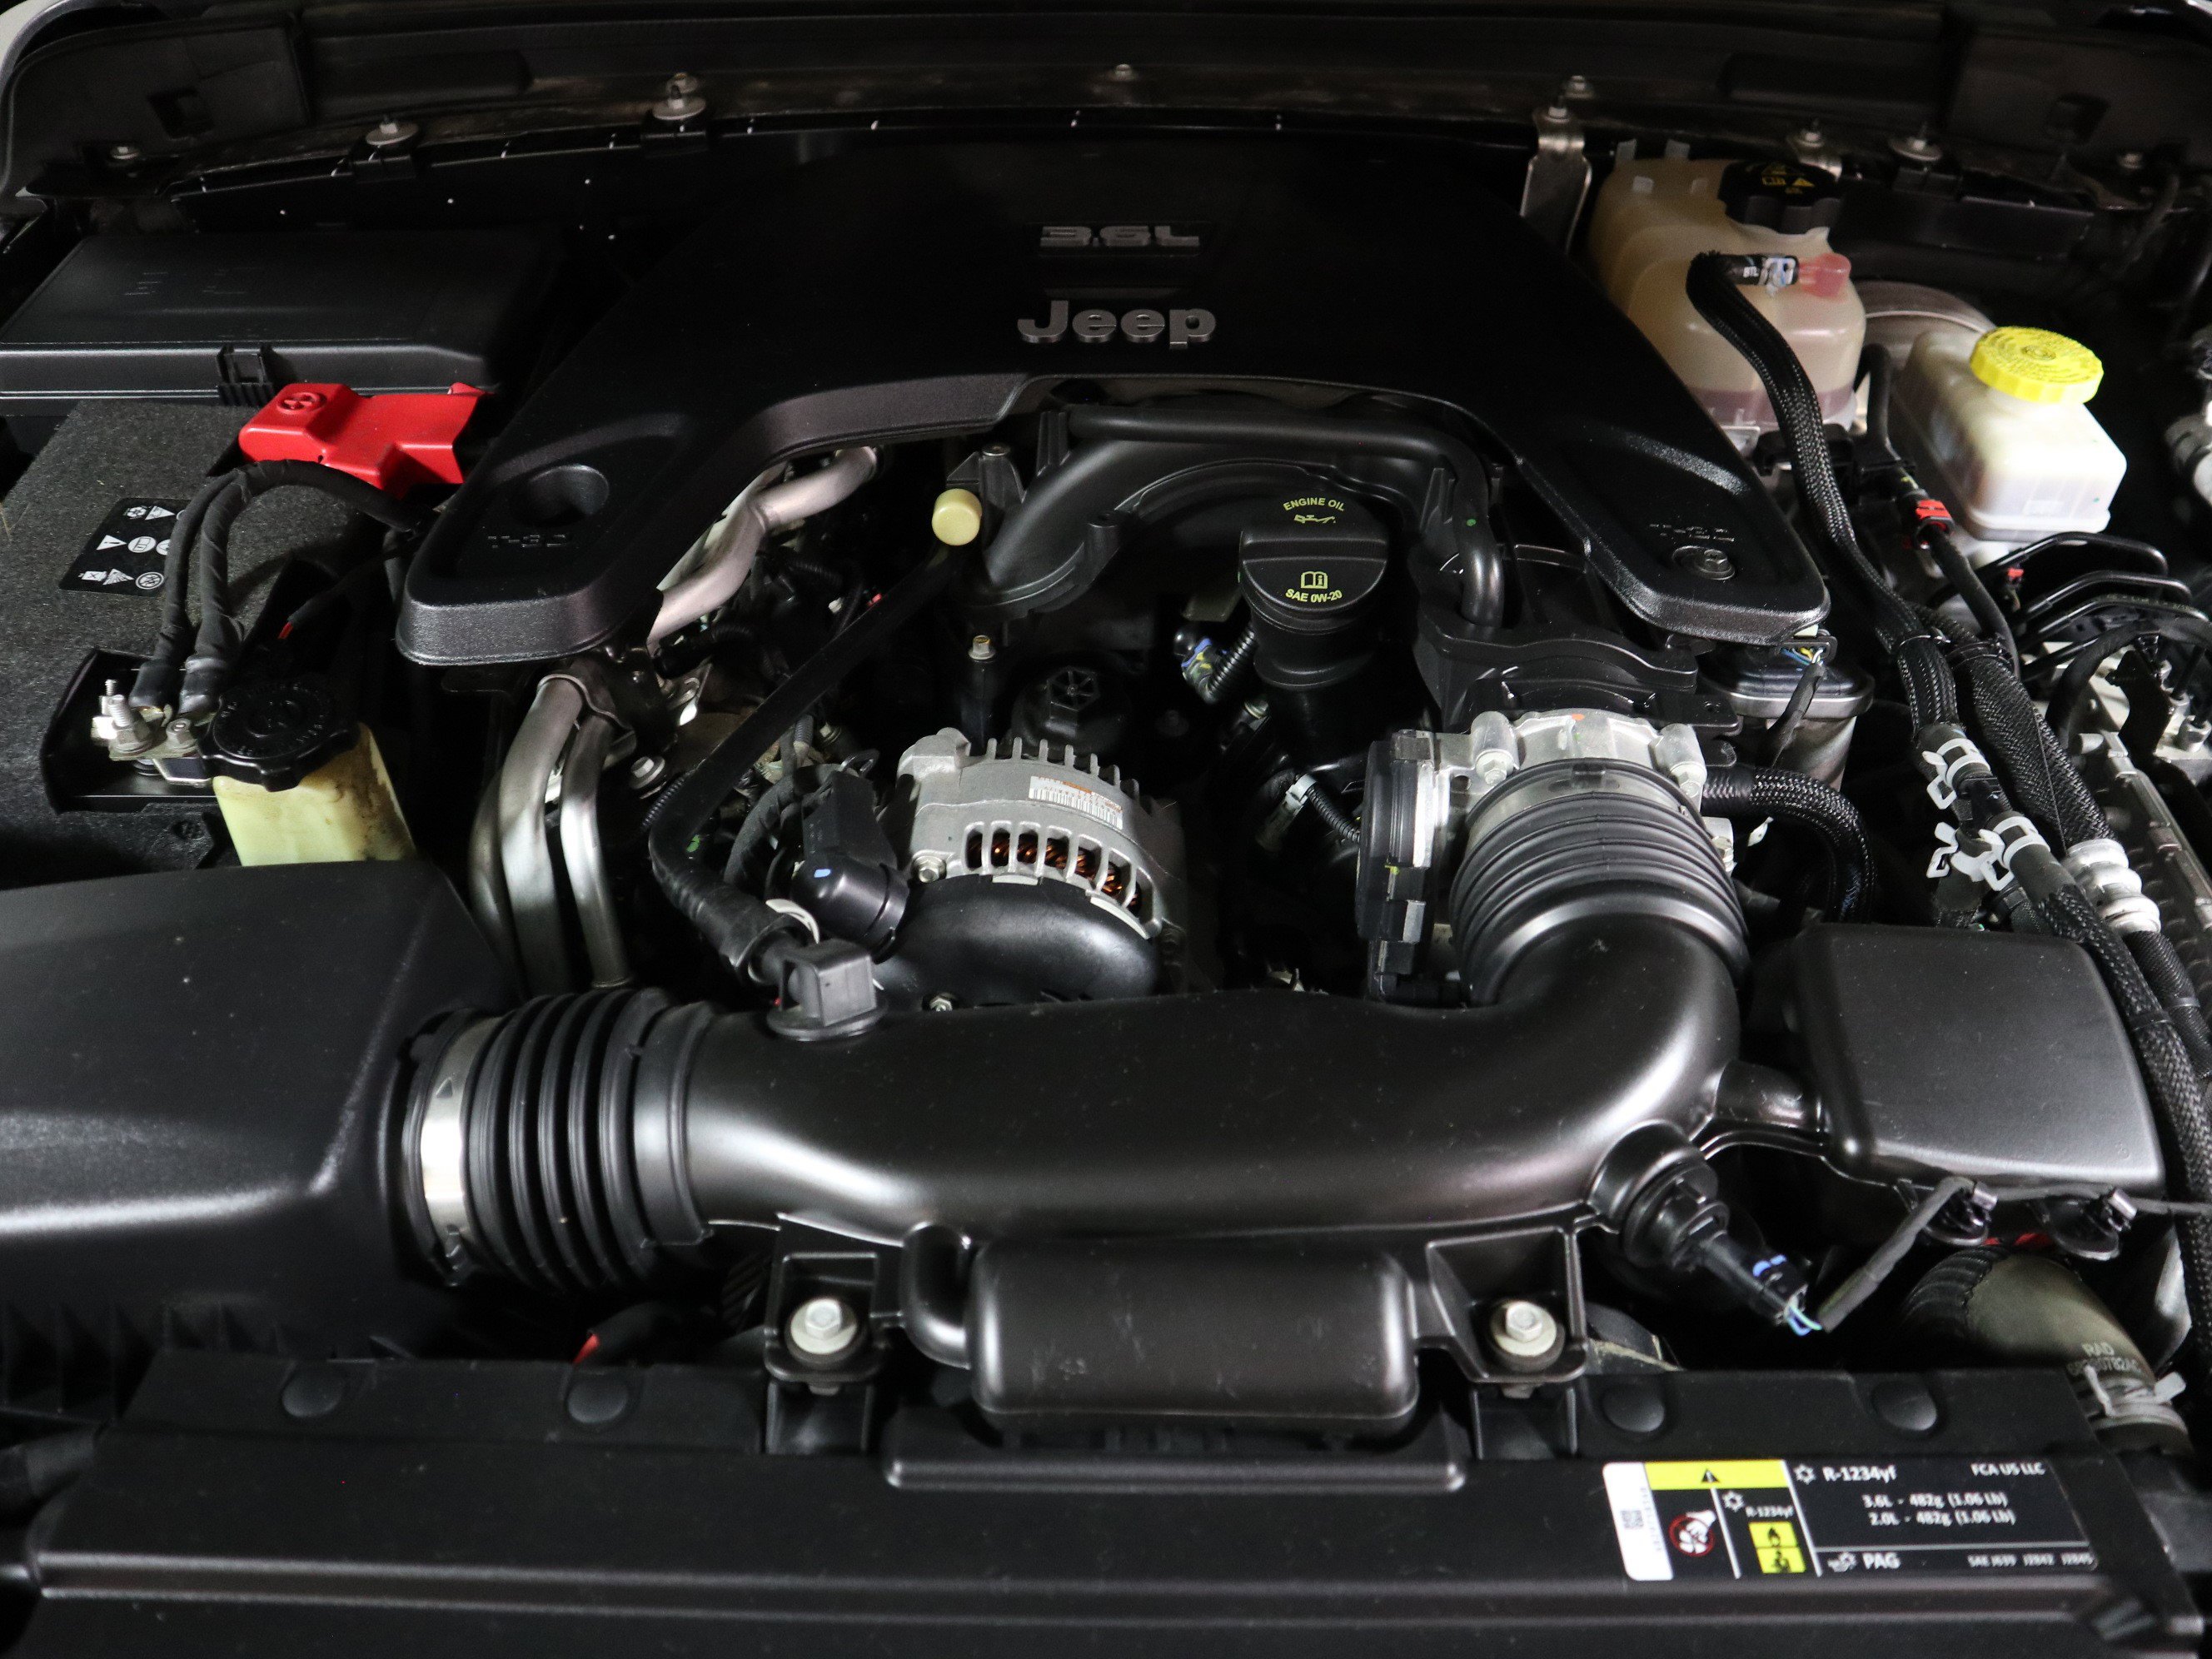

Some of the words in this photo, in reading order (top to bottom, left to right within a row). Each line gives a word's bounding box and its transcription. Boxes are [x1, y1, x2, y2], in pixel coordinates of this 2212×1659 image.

[1039, 226, 1199, 247] 3.6L
[1017, 300, 1217, 349] Jeep
[1283, 497, 1326, 511] ENGINE
[1328, 499, 1345, 511] OIL
[1285, 588, 1308, 602] SAE
[1310, 589, 1343, 603] 0W-20
[2082, 1342, 2115, 1356] RAD
[1822, 1464, 1897, 1483] R-1234yf
[1970, 1462, 1999, 1477] FCA
[2000, 1462, 2019, 1476] US
[2020, 1462, 2046, 1476] LLC
[1862, 1494, 1893, 1509] 3.6L
[1909, 1492, 1945, 1510] 482g
[1746, 1505, 1794, 1520] R-1234yf
[1869, 1512, 1900, 1526] 2.0L
[1916, 1511, 1952, 1527] 482g
[1862, 1552, 1901, 1569] PAG
